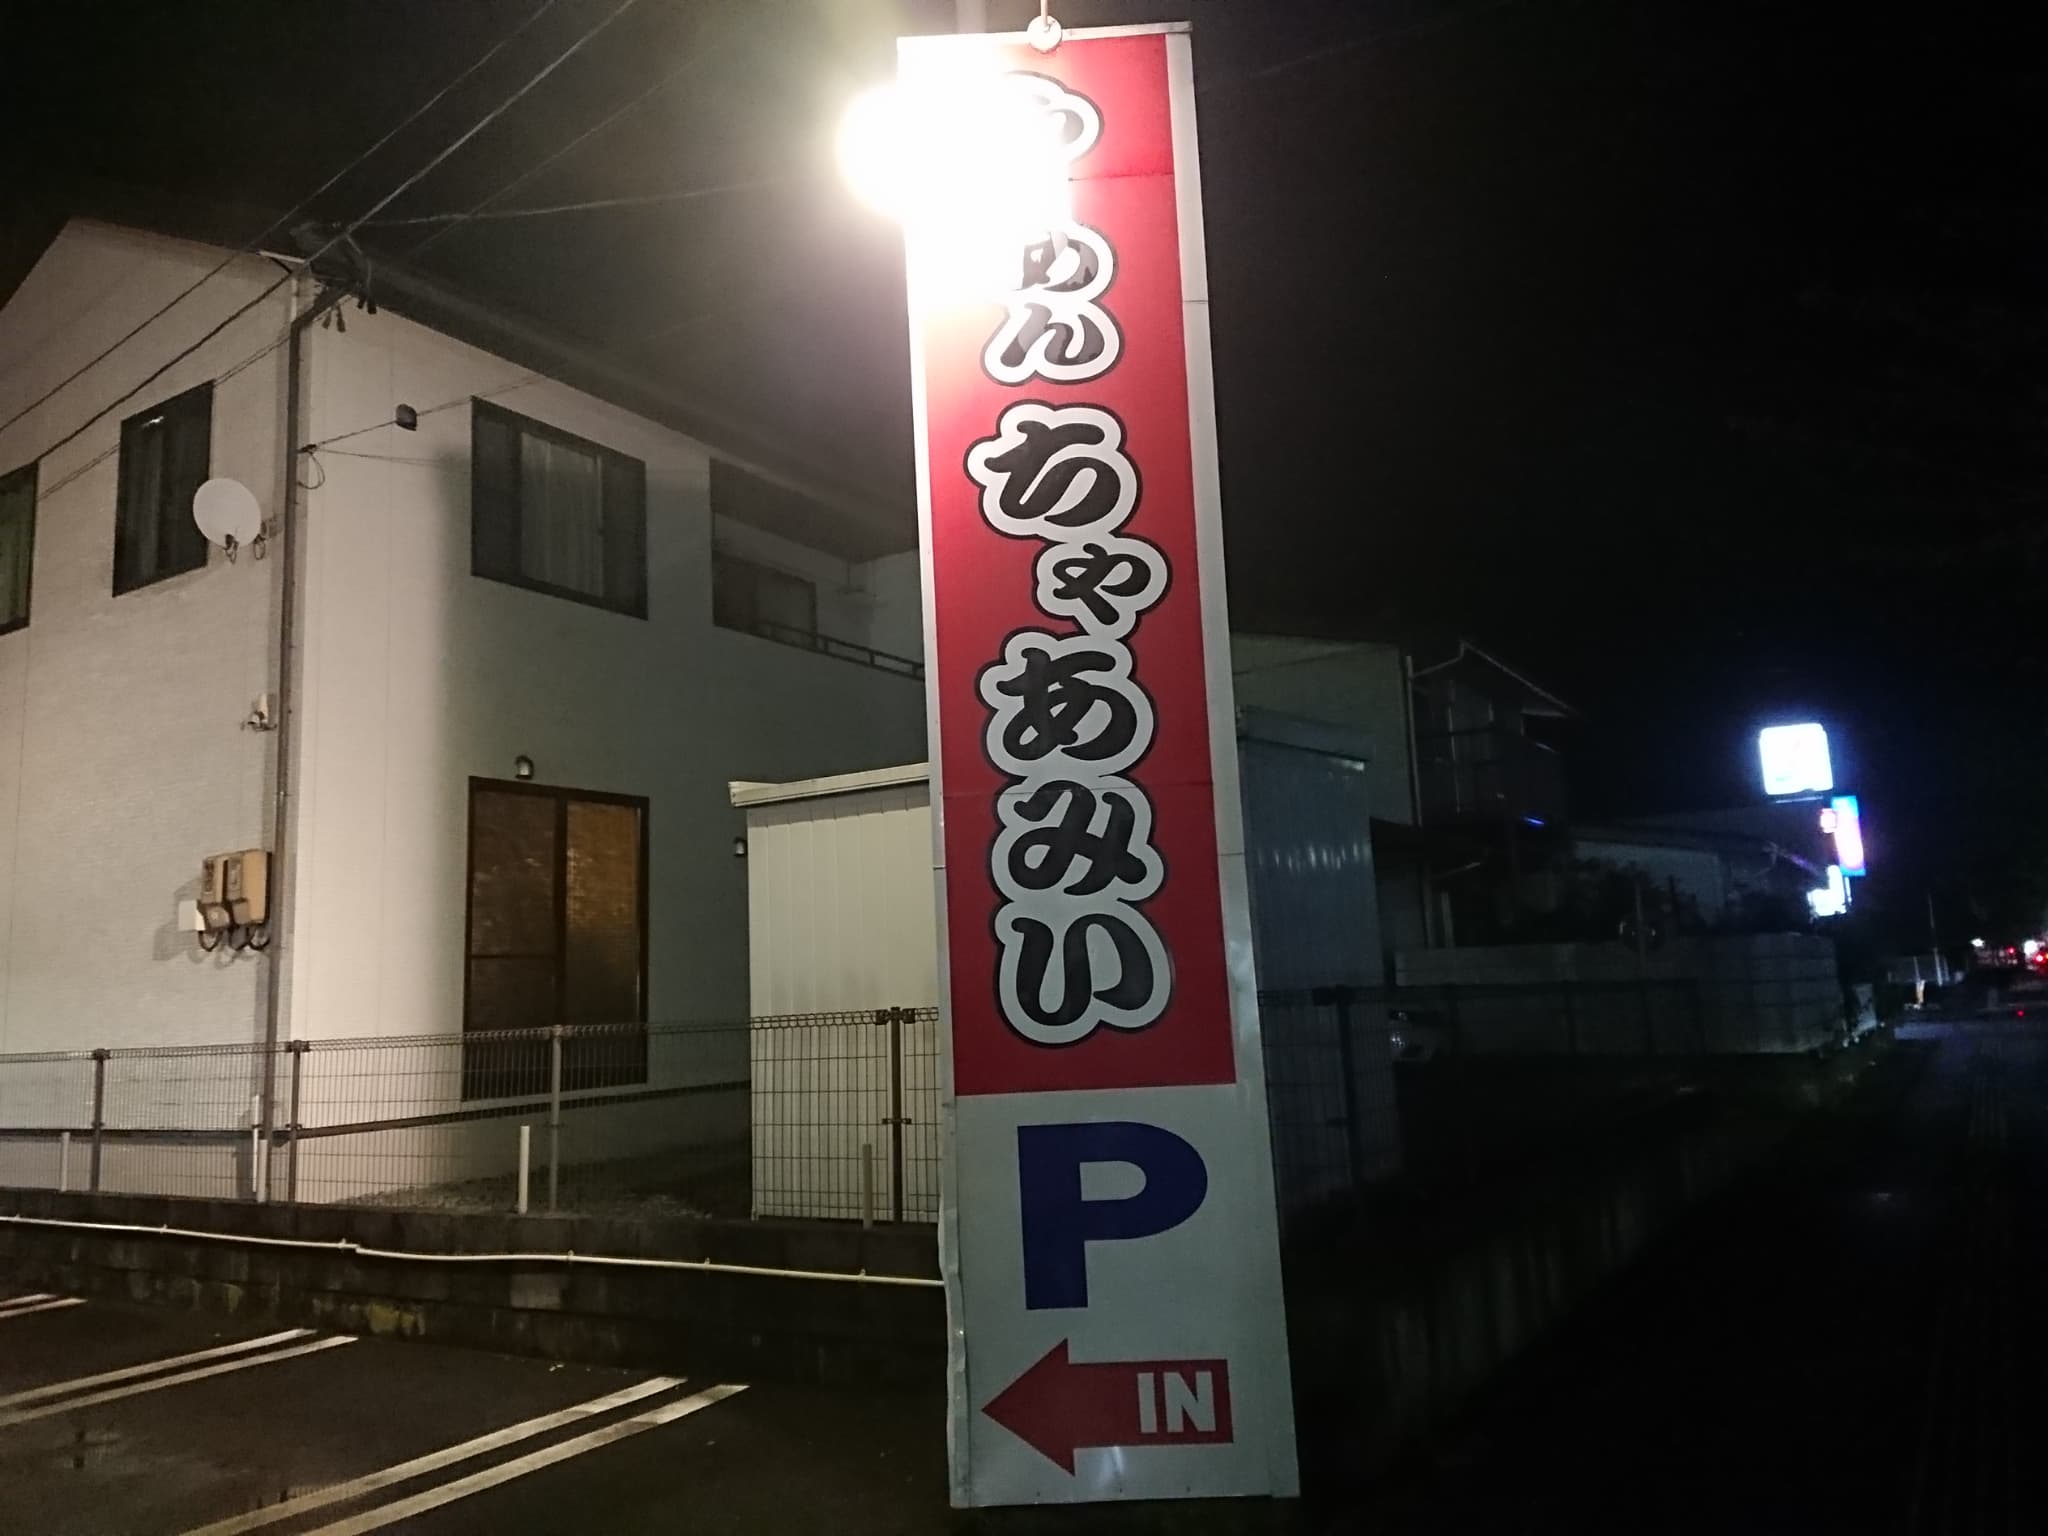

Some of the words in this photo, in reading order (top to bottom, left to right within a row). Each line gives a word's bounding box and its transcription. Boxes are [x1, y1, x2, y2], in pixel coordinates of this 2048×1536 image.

[974, 409, 1164, 1038] ちゃあみい
[1017, 1121, 1208, 1310] P
[1137, 1371, 1216, 1433] IN
